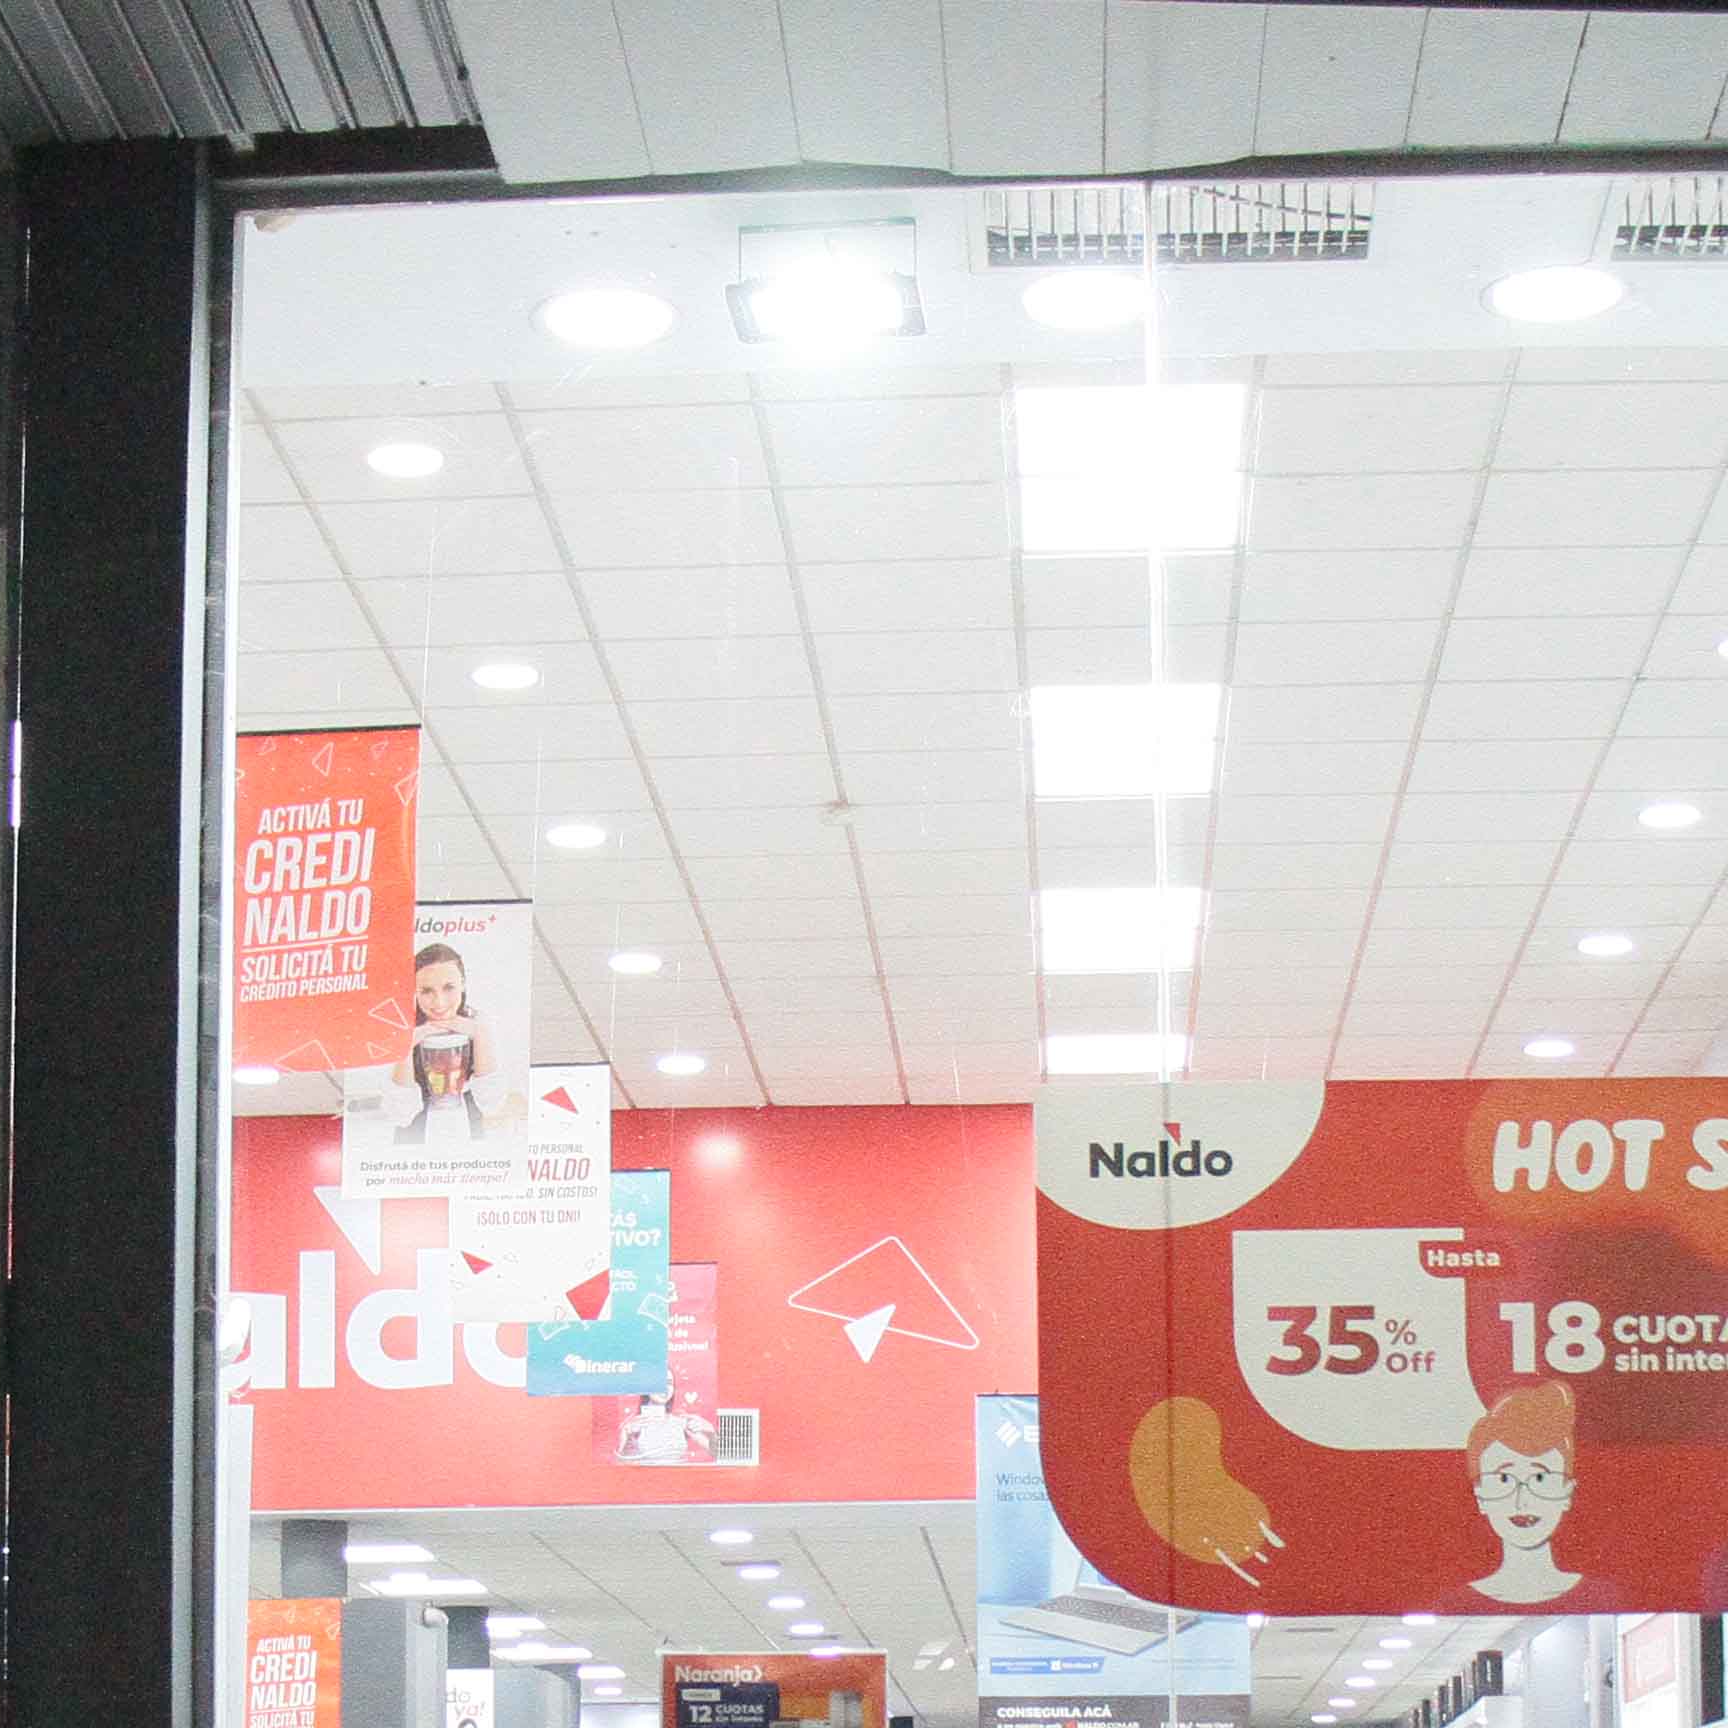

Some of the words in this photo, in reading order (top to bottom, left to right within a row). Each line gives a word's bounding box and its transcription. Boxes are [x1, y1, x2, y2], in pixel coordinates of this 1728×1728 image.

[258, 798, 332, 835] ACTIVÁ
[337, 798, 365, 826] TU
[244, 827, 377, 895] CREDI
[242, 885, 372, 946] NALDO
[240, 943, 335, 983] SOLICITÁ
[341, 943, 369, 972] TU
[299, 973, 369, 998] PERSONAL
[451, 1158, 512, 1173] productos
[1089, 1140, 1234, 1178] Naldo
[1491, 1118, 1666, 1193] HOT
[513, 1211, 537, 1225] CON
[540, 1210, 555, 1224] TU
[1426, 1248, 1501, 1268] Hasta
[222, 1248, 529, 1389] ald
[1265, 1305, 1381, 1376] 35
[1384, 1319, 1418, 1346] %
[1498, 1300, 1606, 1374] 18
[1385, 1351, 1436, 1374] Off
[1614, 1349, 1663, 1372] sin
[296, 1635, 312, 1649] TU
[250, 1650, 318, 1684] CREDI
[675, 1664, 754, 1687] Naranja
[250, 1680, 317, 1711] NALDO
[299, 1710, 315, 1726] TU
[688, 1705, 714, 1725] 12
[996, 1706, 1081, 1719] CONSEGUILA
[1082, 1704, 1113, 1719] ACÁ
